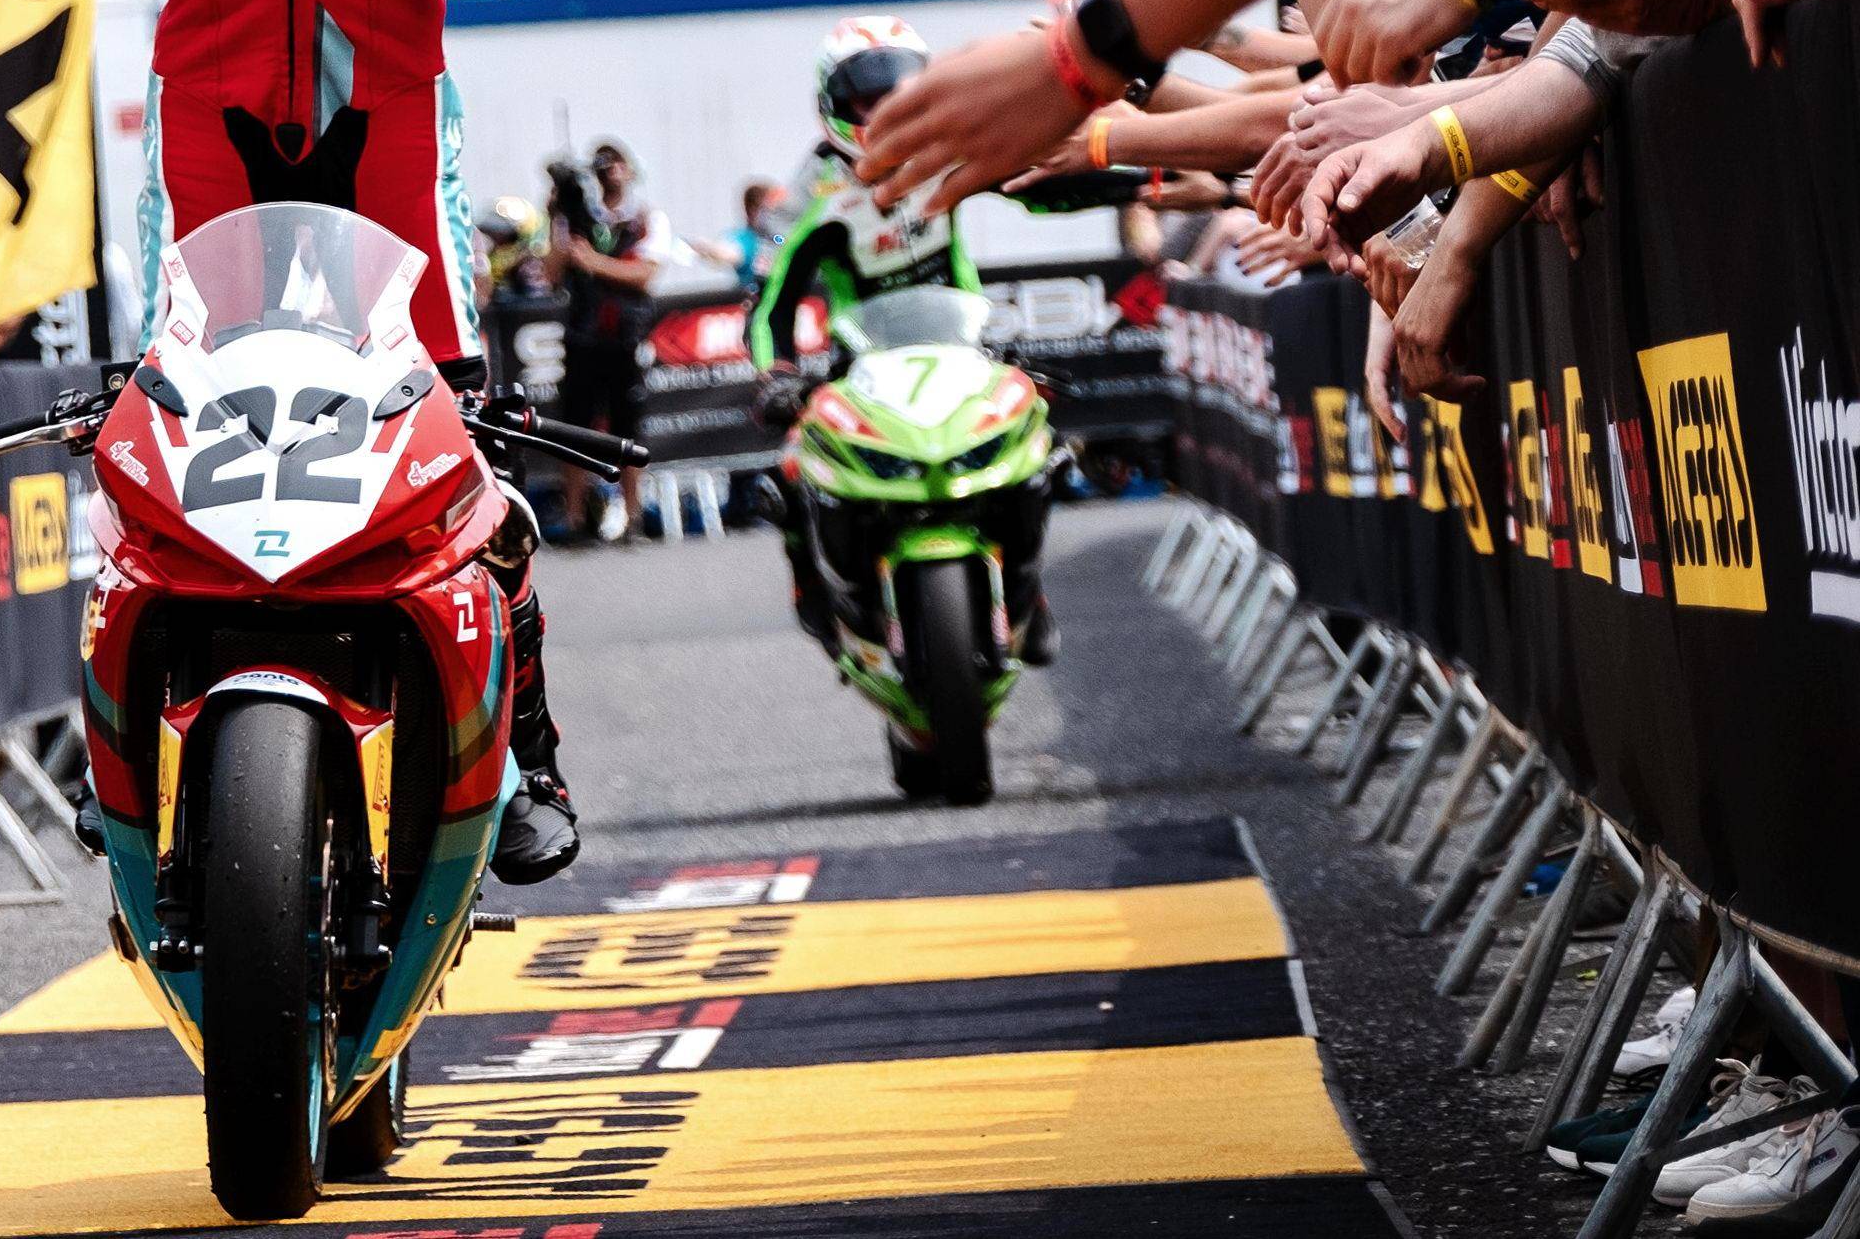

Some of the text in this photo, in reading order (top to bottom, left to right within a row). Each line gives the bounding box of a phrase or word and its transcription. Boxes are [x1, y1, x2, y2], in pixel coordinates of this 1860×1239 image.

[907, 356, 938, 406] 7
[182, 385, 369, 513] 22
[1656, 375, 1754, 569] ACERBIS
